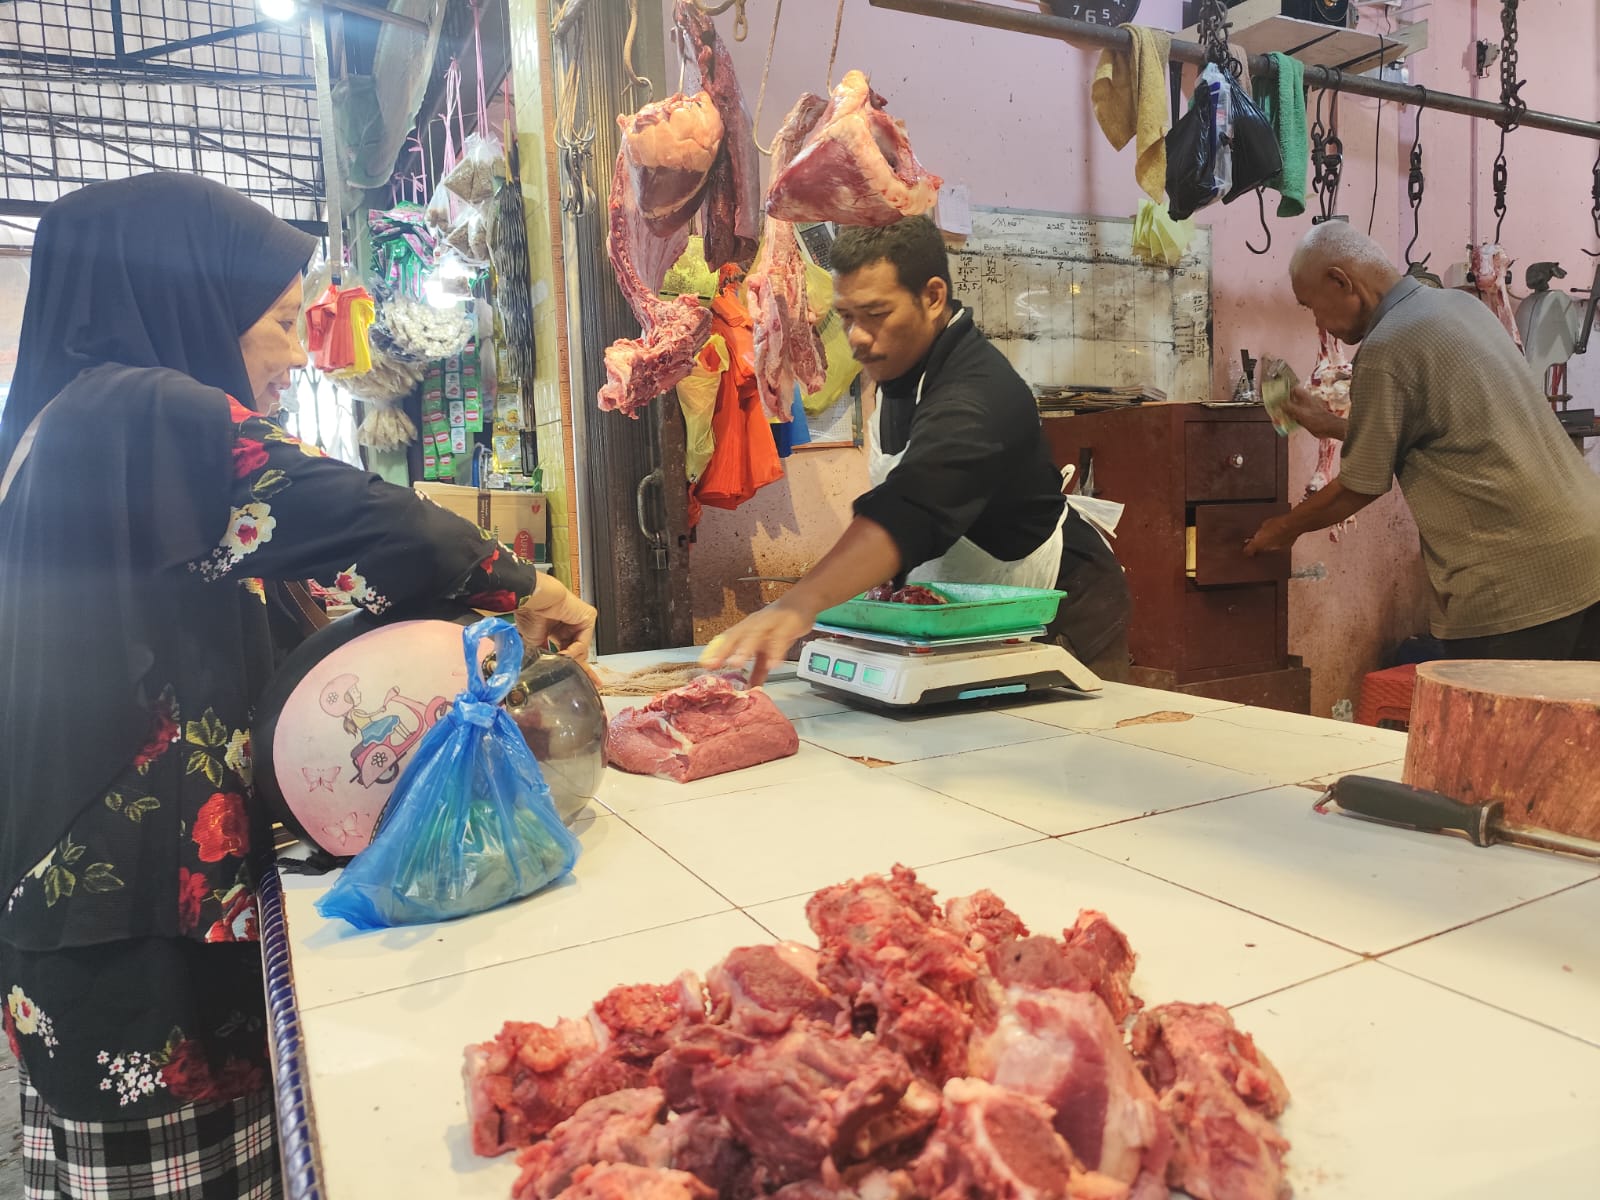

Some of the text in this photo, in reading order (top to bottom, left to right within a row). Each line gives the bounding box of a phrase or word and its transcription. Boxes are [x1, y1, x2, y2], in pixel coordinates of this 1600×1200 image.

[1073, 5, 1080, 15] 7
[1102, 9, 1110, 19] 5
[1085, 10, 1096, 23] 6
